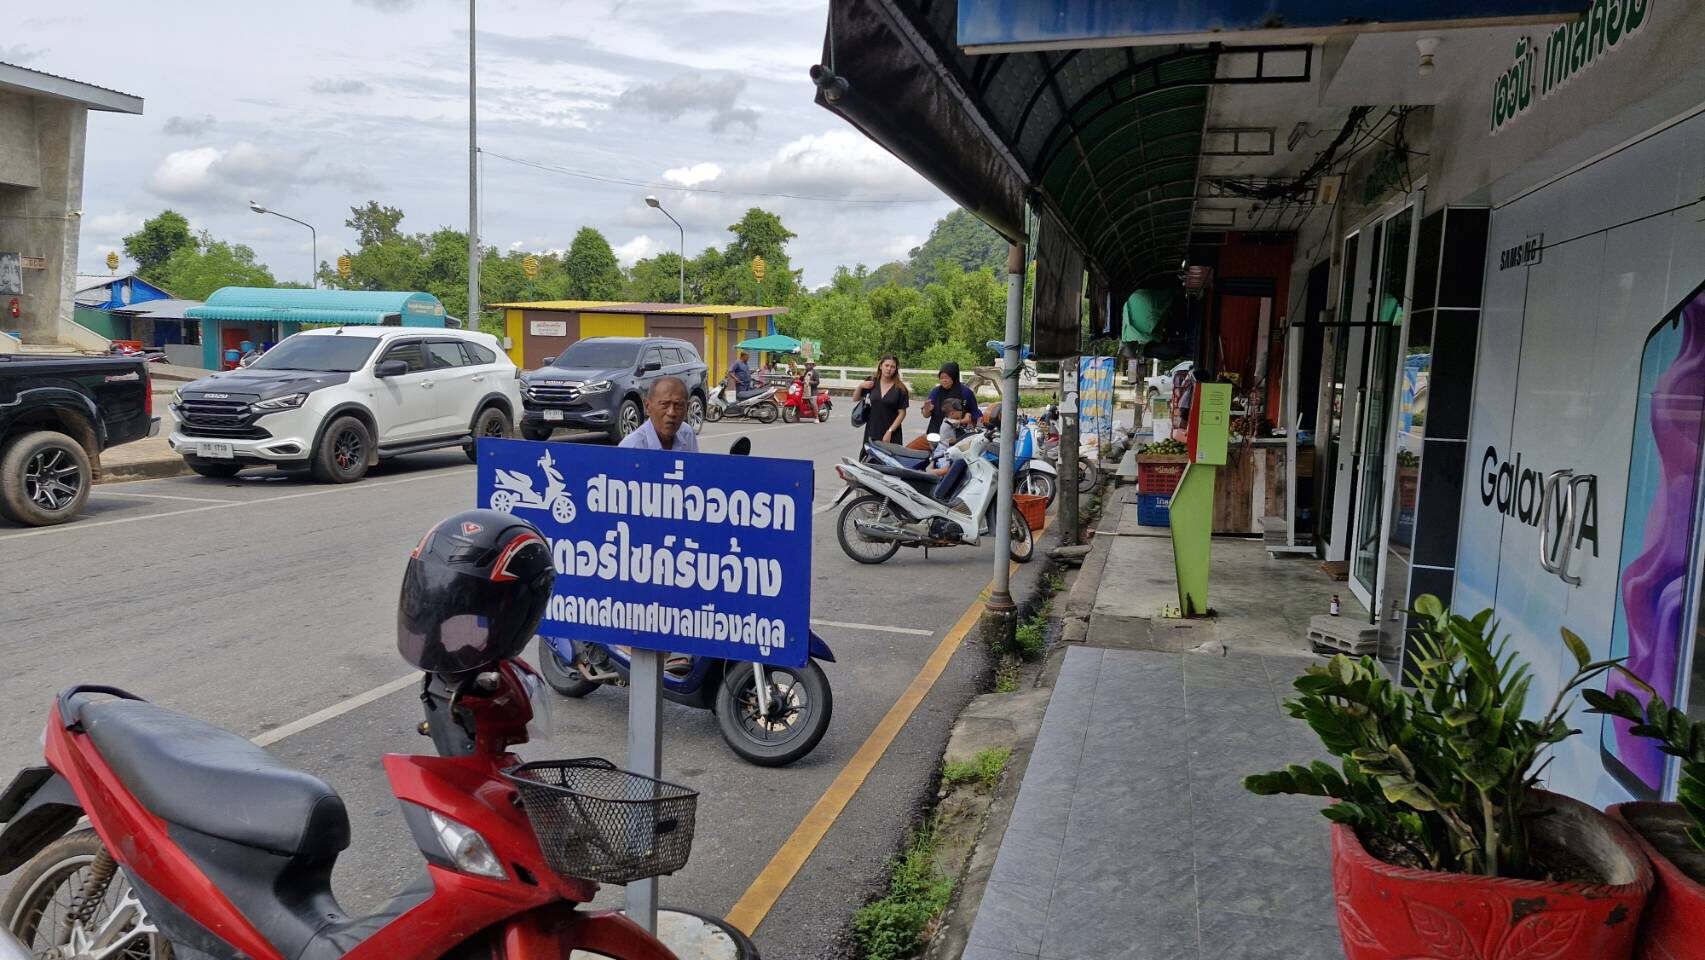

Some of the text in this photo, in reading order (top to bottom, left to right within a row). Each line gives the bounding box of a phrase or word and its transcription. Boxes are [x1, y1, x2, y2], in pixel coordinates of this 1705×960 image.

[1500, 239, 1536, 271] SAMSNG
[587, 461, 795, 531] สถานที่จอดรถ
[1575, 474, 1599, 558] A
[546, 521, 782, 597] ตอร์ไซค์รับจ้าง
